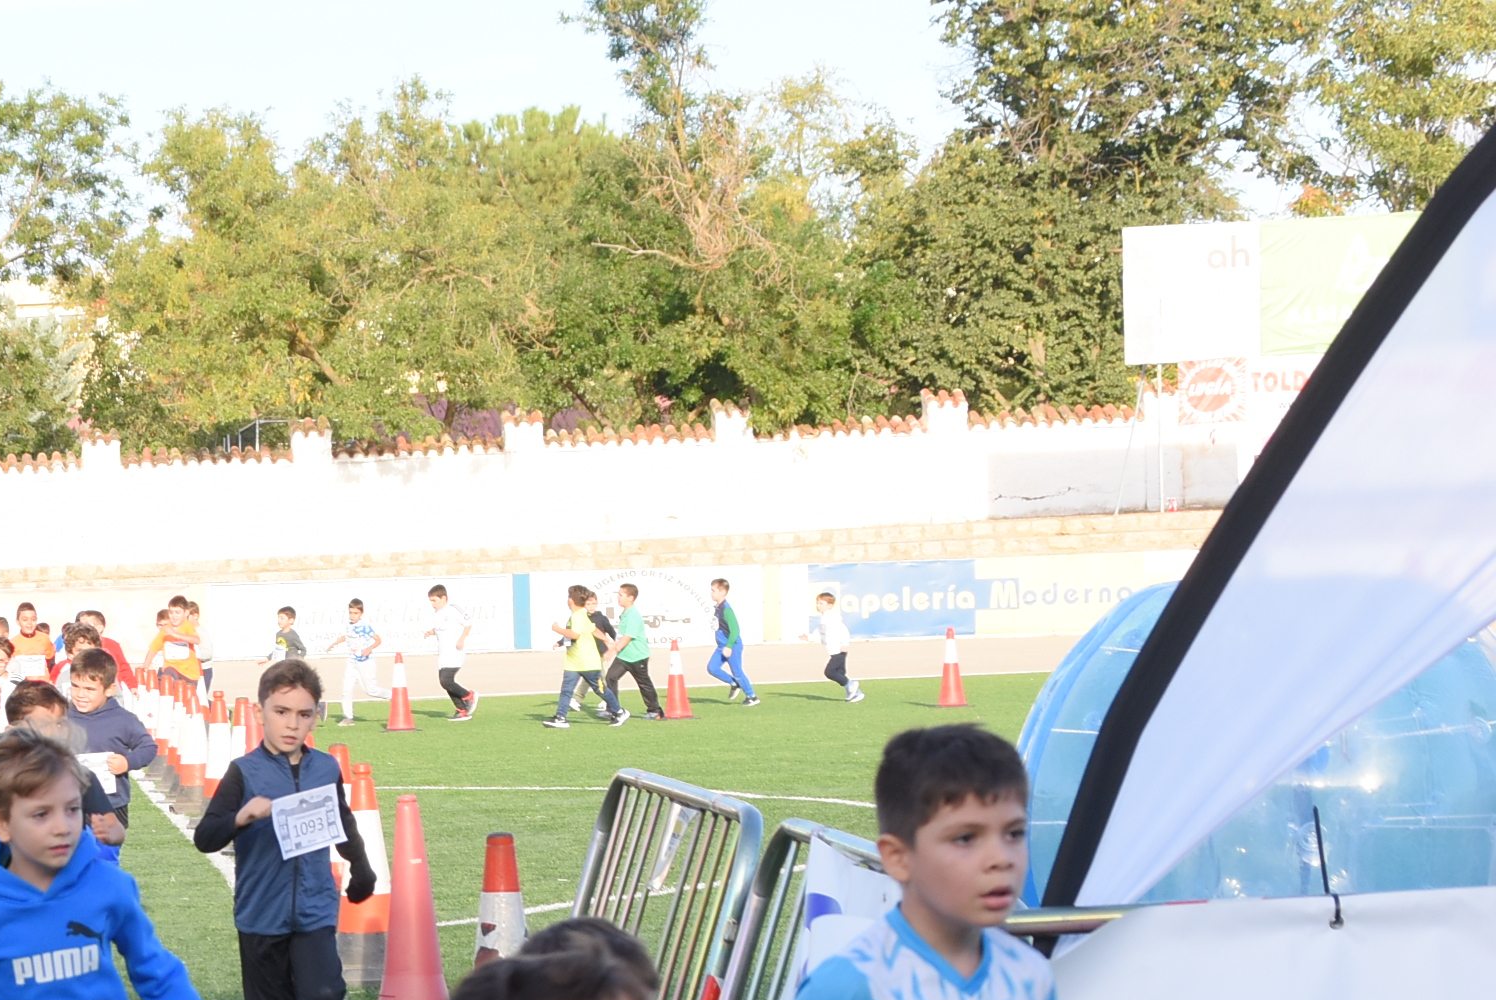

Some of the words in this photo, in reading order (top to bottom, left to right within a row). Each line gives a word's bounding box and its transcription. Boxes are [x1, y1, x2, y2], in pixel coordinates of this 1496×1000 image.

[593, 570, 637, 591] UGENIO
[822, 583, 977, 619] apelería
[293, 817, 325, 839] 1093
[11, 943, 101, 986] PUMA
